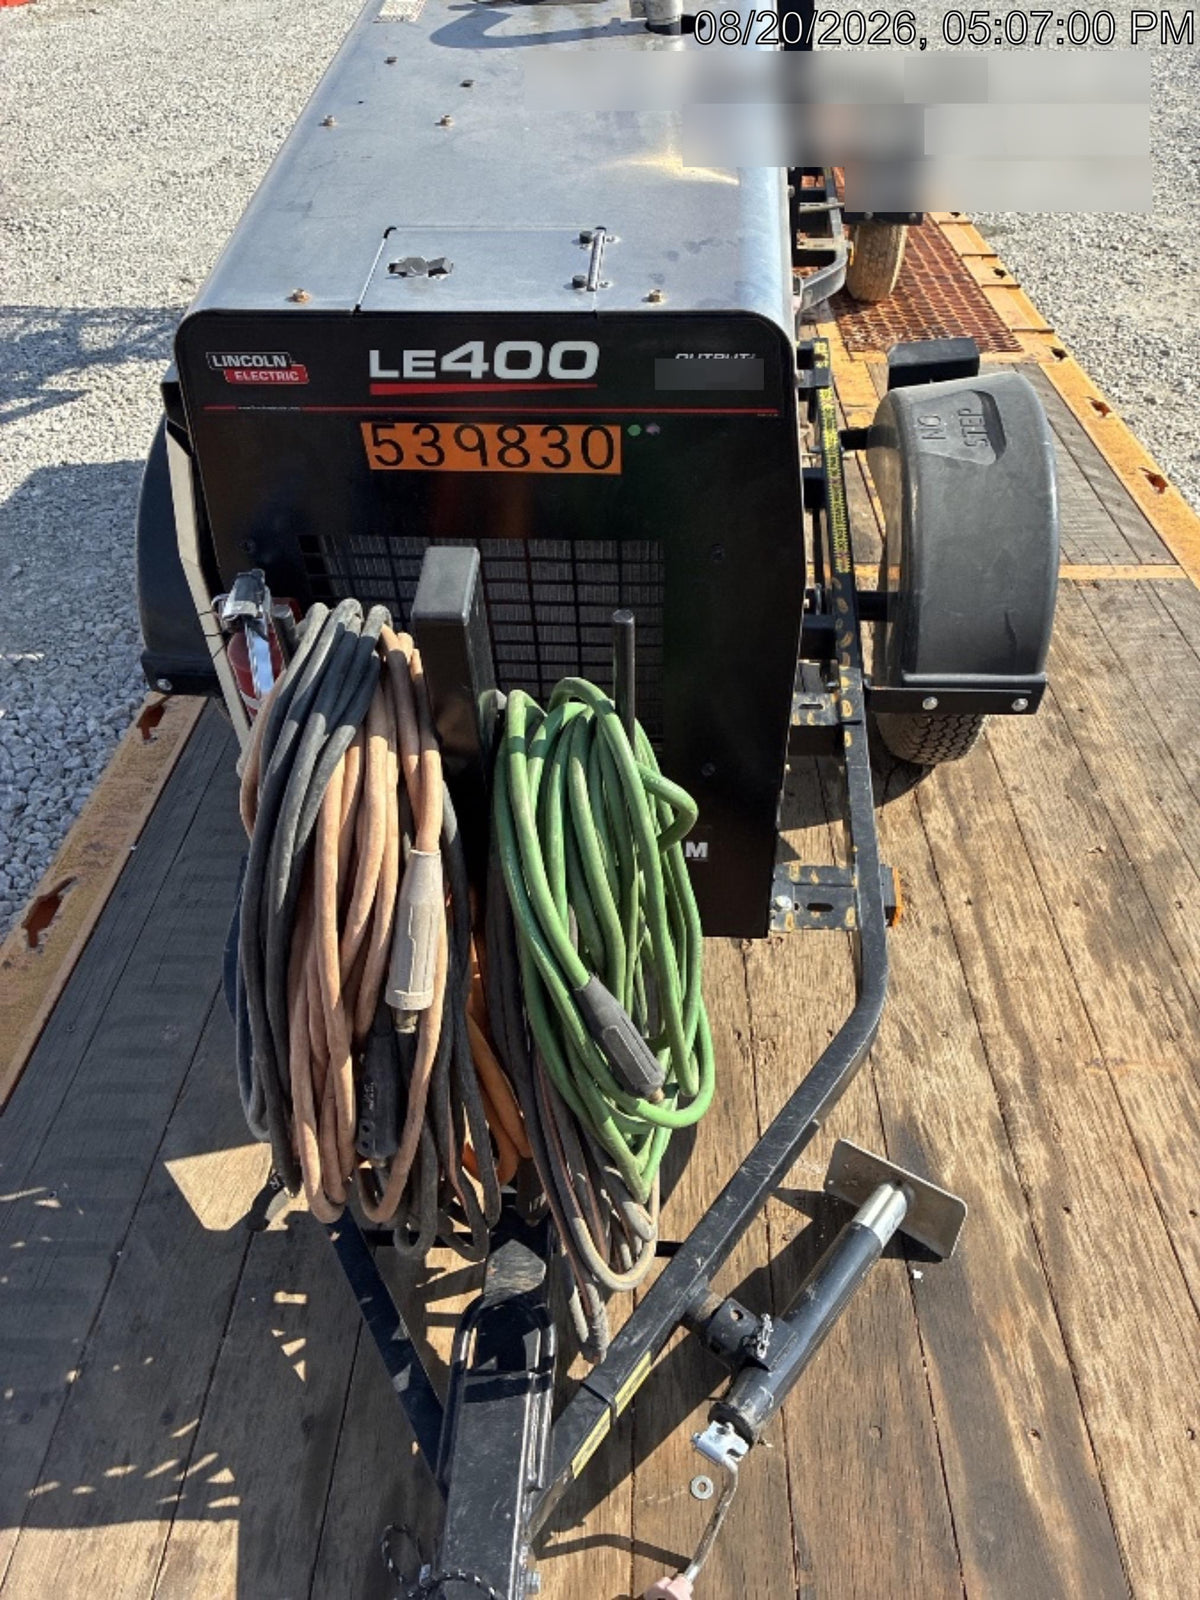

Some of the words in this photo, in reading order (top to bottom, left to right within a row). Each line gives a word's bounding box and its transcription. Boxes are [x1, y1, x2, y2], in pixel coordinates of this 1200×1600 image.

[211, 354, 288, 368] LINCOLN
[234, 370, 300, 382] ELECTRIC
[368, 340, 600, 380] LE400
[917, 415, 947, 440] NO
[957, 408, 990, 447] STEP
[370, 422, 615, 470] 539830
